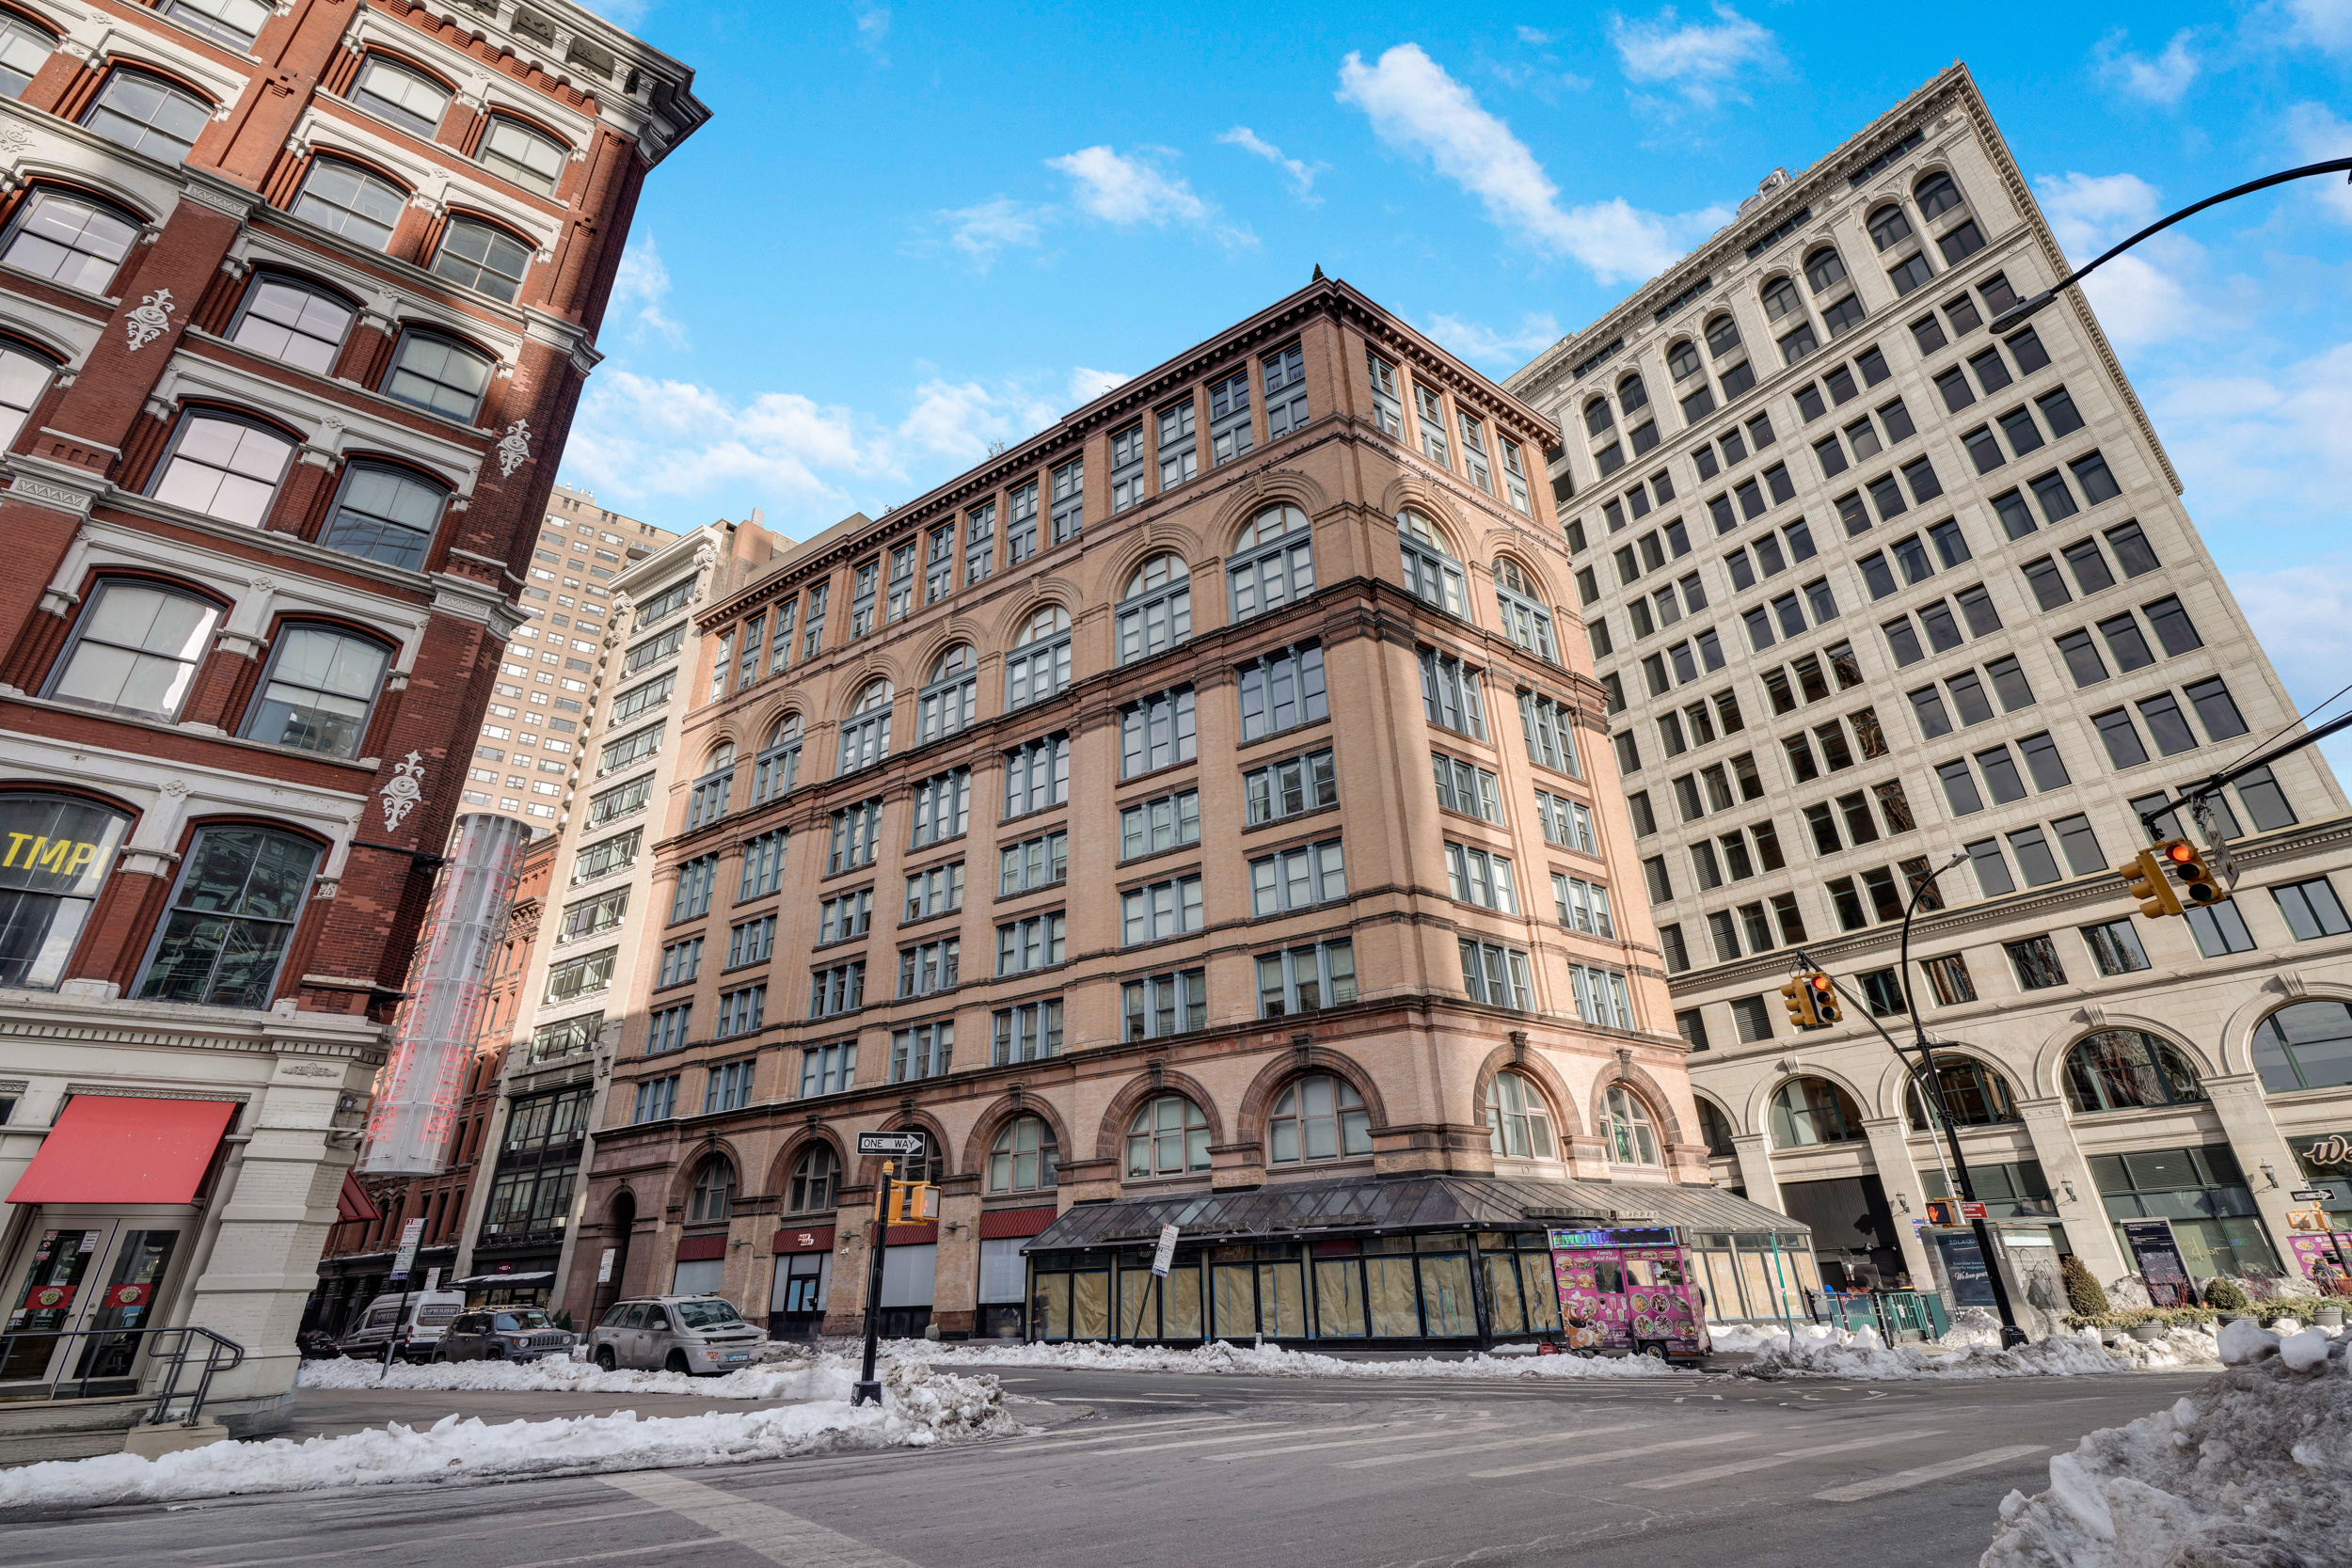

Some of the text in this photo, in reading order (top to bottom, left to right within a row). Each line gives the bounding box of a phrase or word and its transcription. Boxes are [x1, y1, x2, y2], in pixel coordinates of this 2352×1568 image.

[421, 975, 489, 1144] RAISING
[864, 1138, 915, 1148] ONE WAY
[1992, 1231, 2006, 1259] Newsstand
[1954, 1271, 1965, 1281] We
[1975, 1271, 1988, 1281] your
